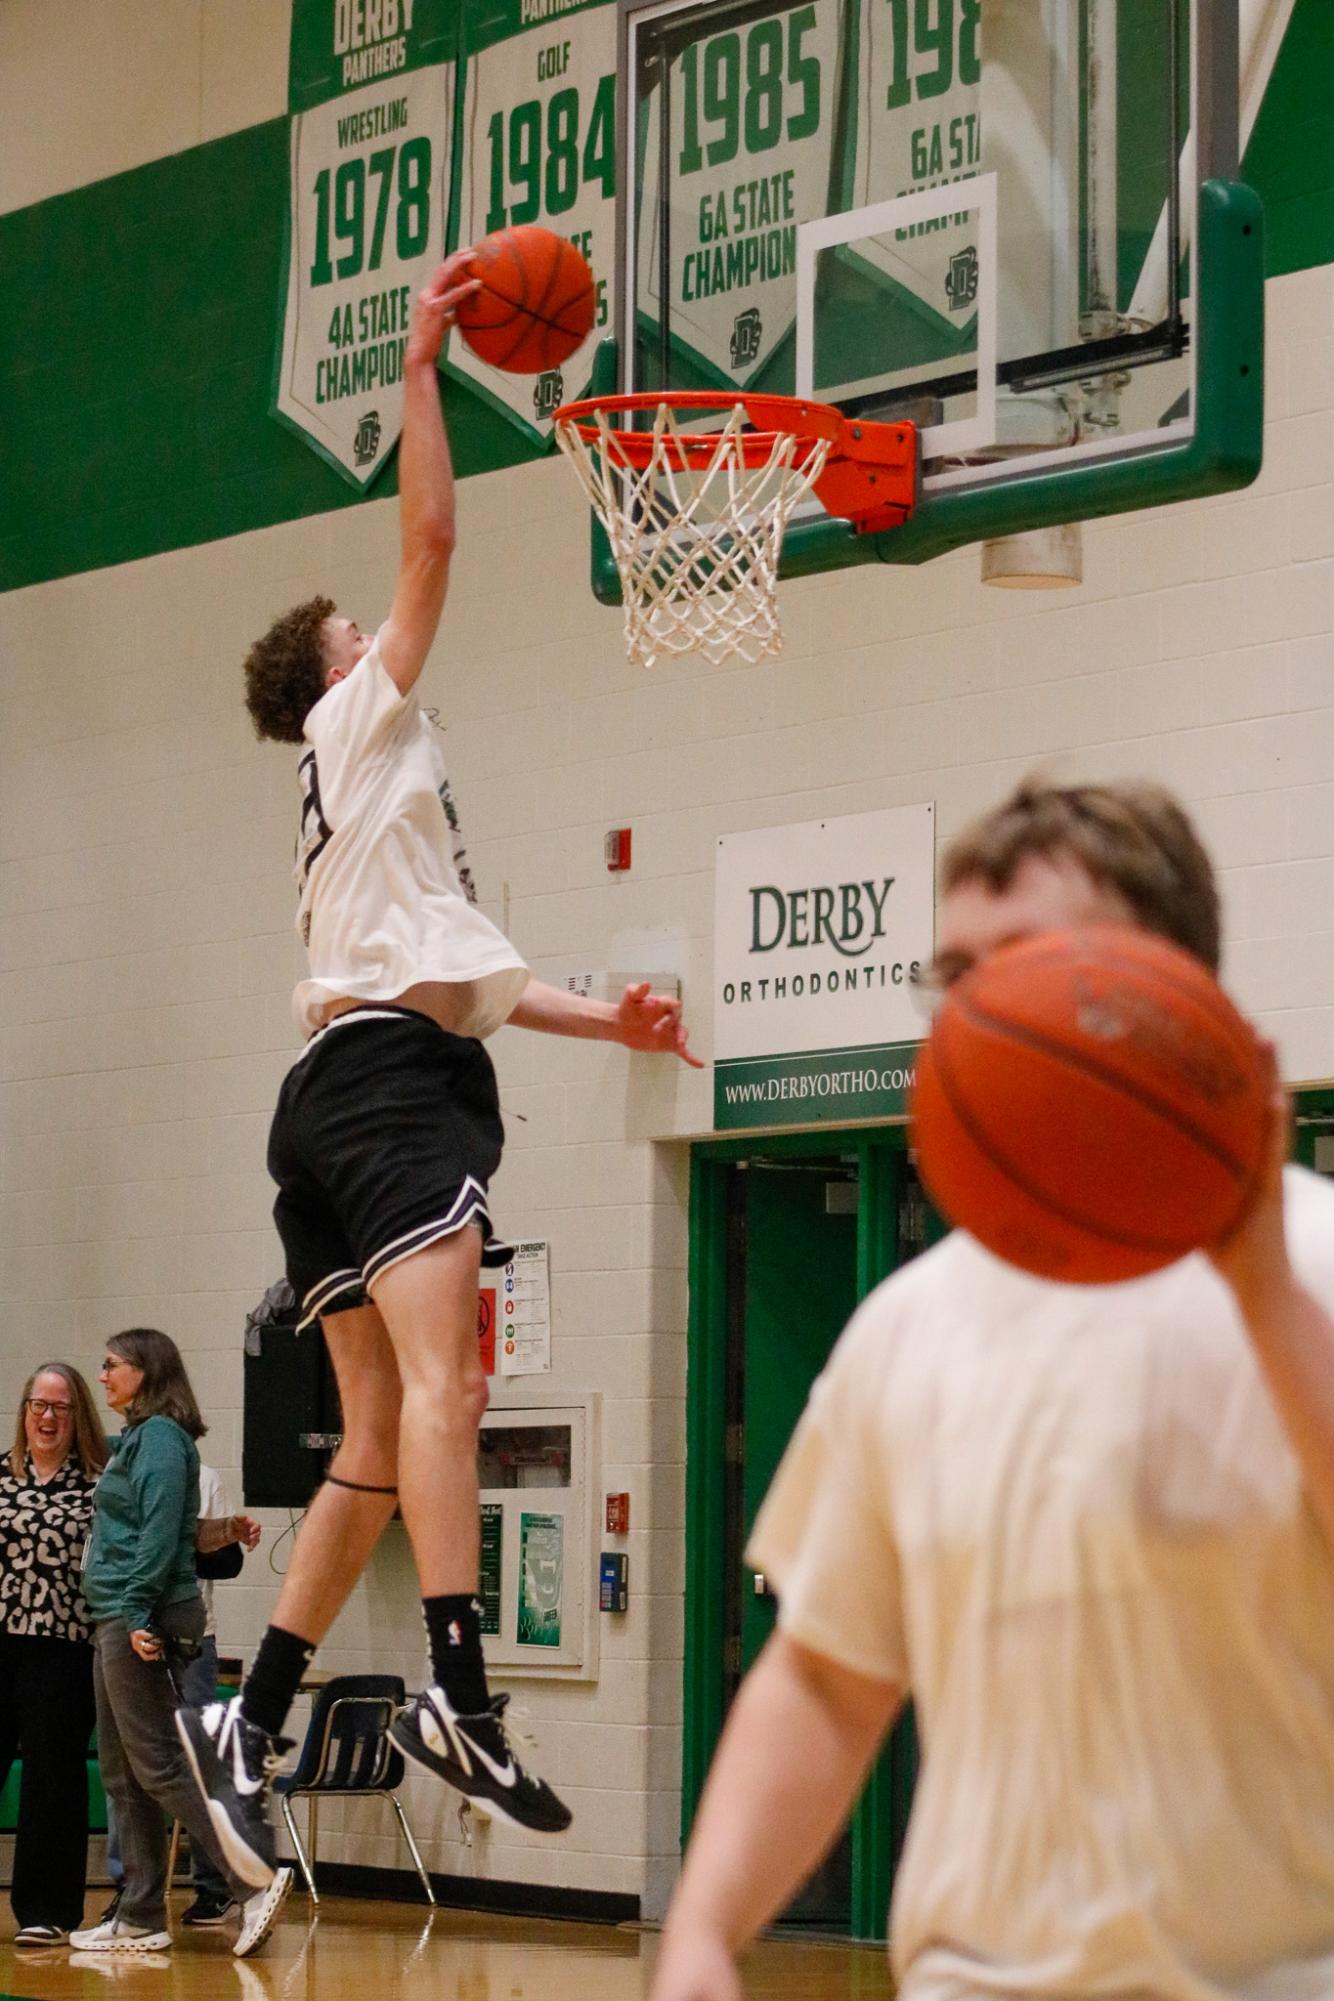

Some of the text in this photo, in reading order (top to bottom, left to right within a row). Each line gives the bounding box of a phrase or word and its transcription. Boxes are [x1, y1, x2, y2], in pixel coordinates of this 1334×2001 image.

[342, 36, 407, 87] PANTHERS
[537, 41, 572, 82] GOLF
[886, 0, 981, 110] 198
[337, 97, 408, 149] WRESTLING
[680, 5, 821, 177] 1985
[486, 73, 616, 235] 1984
[911, 124, 943, 180] 6A
[310, 136, 432, 288] 1978
[700, 169, 795, 244] 6A STATE
[681, 225, 798, 302] CHAMPION
[328, 285, 411, 350] 4A STATE
[316, 336, 409, 405] CHAMPION
[748, 877, 895, 957] DERBY
[723, 961, 921, 1005] ORTHODONTICS
[725, 1069, 917, 1105] WWW.DERBYORTHO.COM
